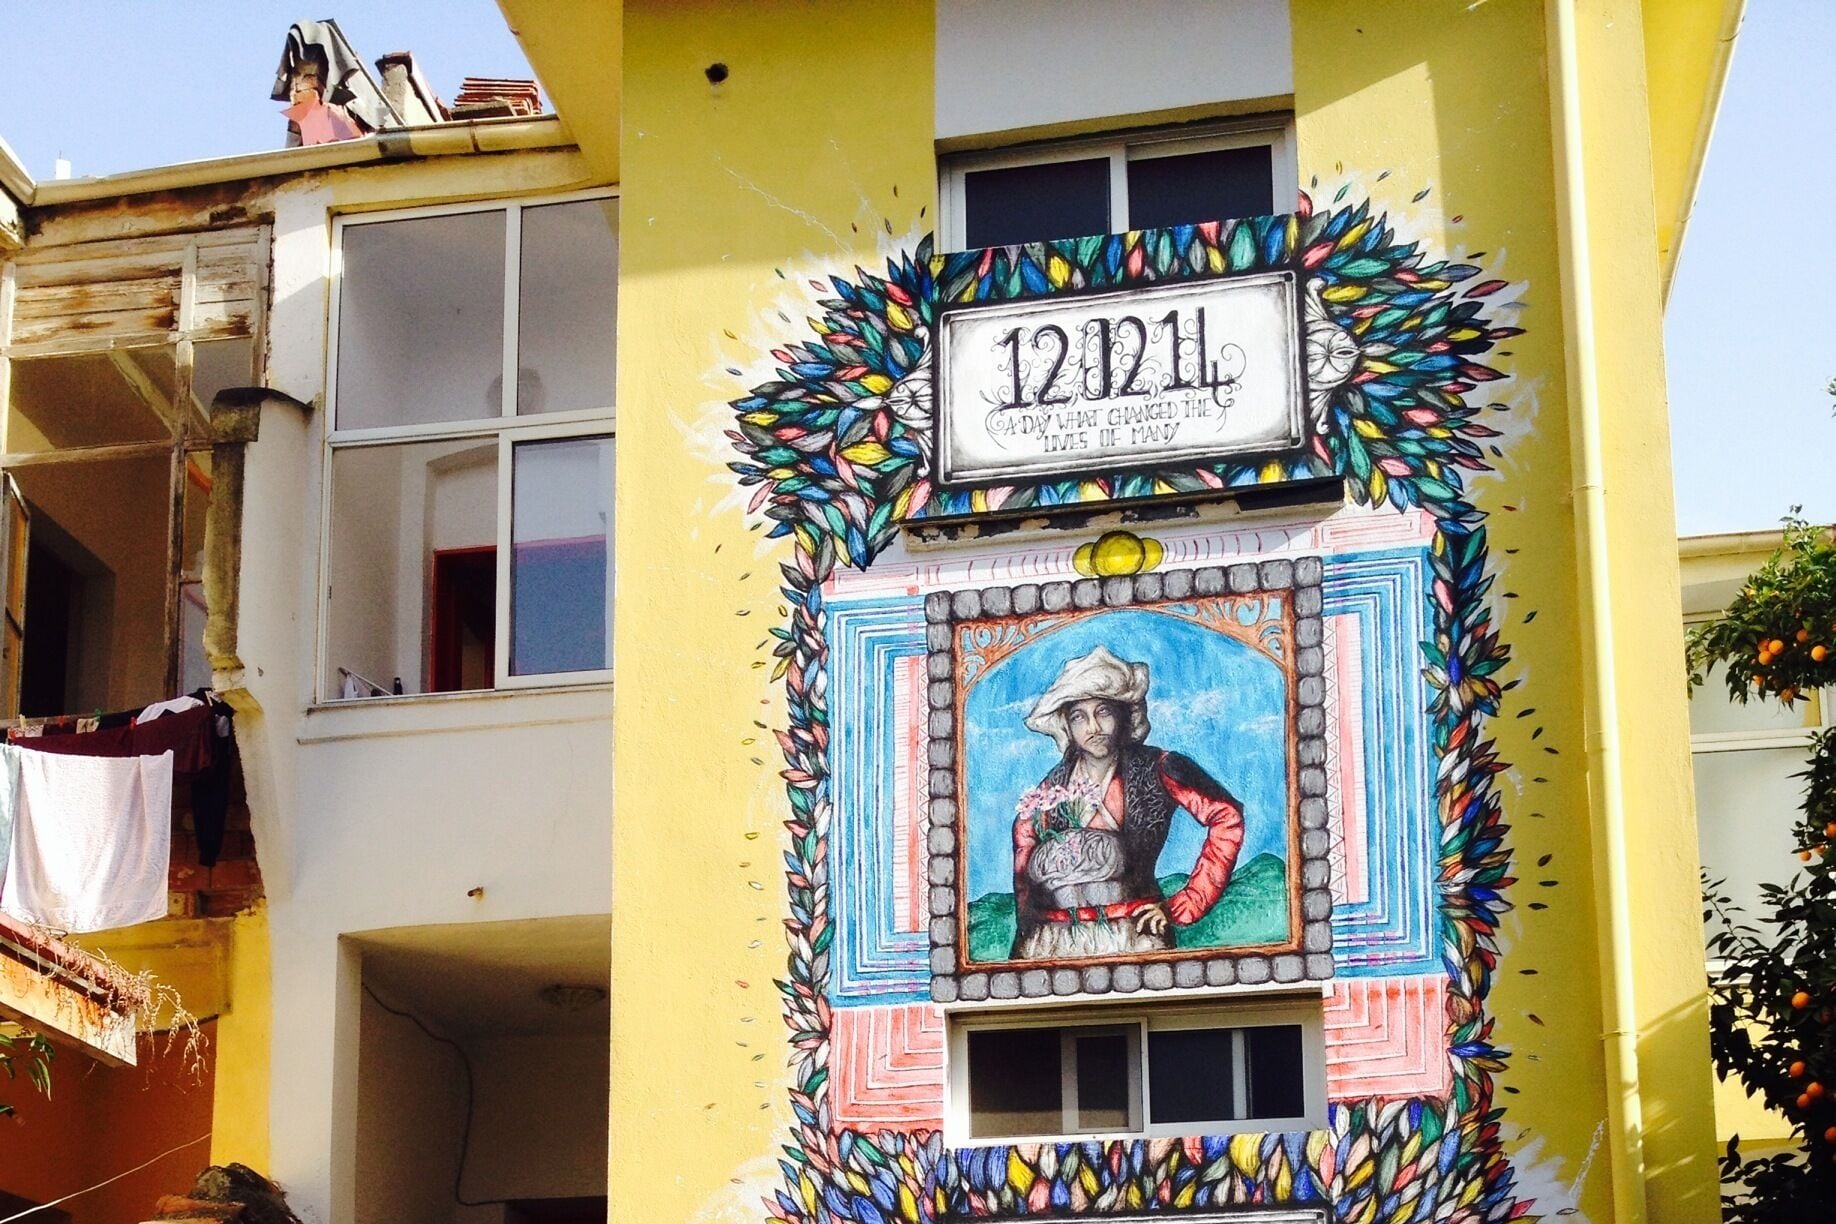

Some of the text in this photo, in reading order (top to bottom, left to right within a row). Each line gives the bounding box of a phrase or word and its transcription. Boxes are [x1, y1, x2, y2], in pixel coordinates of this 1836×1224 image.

[1003, 397, 1212, 440] A DAY WHAT CHANGED THE
[1044, 422, 1180, 452] LIVES OF MANY
